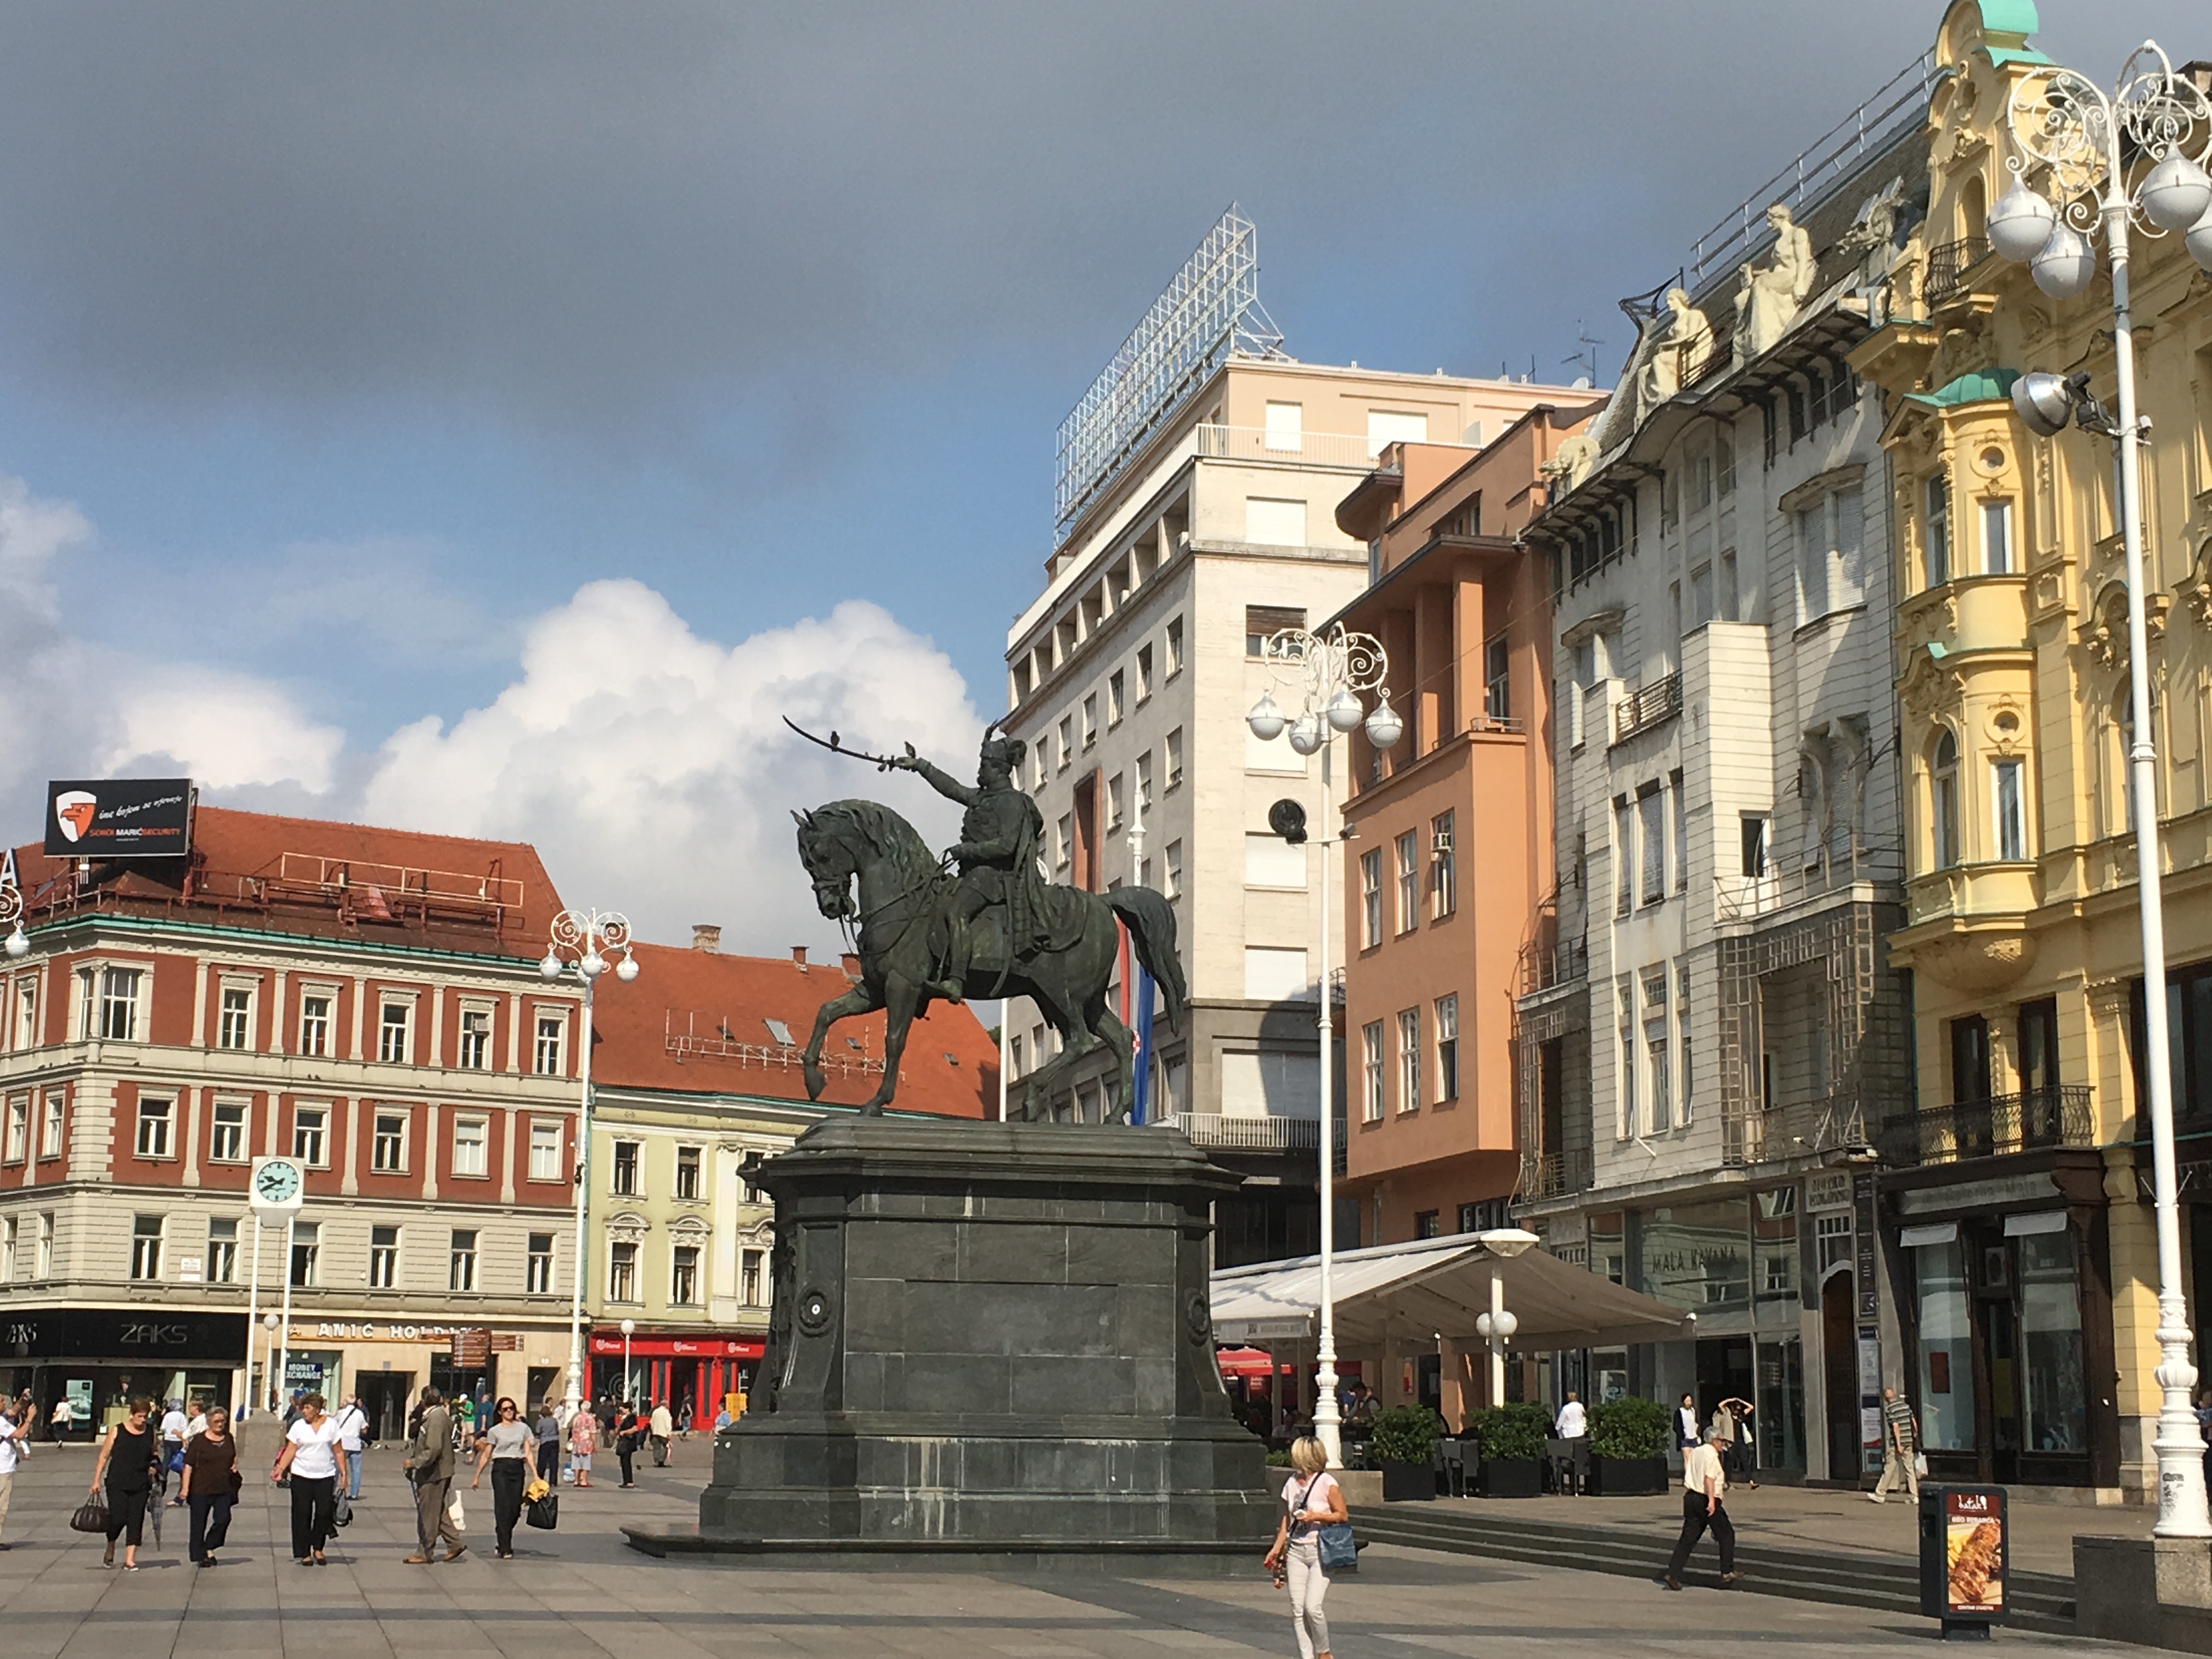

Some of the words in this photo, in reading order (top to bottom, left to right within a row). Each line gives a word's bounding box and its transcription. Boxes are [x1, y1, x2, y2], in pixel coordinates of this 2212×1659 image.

[1652, 1251, 1685, 1273] MALA
[1690, 1245, 1737, 1270] KAVANA
[120, 1324, 188, 1344] ZAKS
[288, 1363, 316, 1371] MONEY
